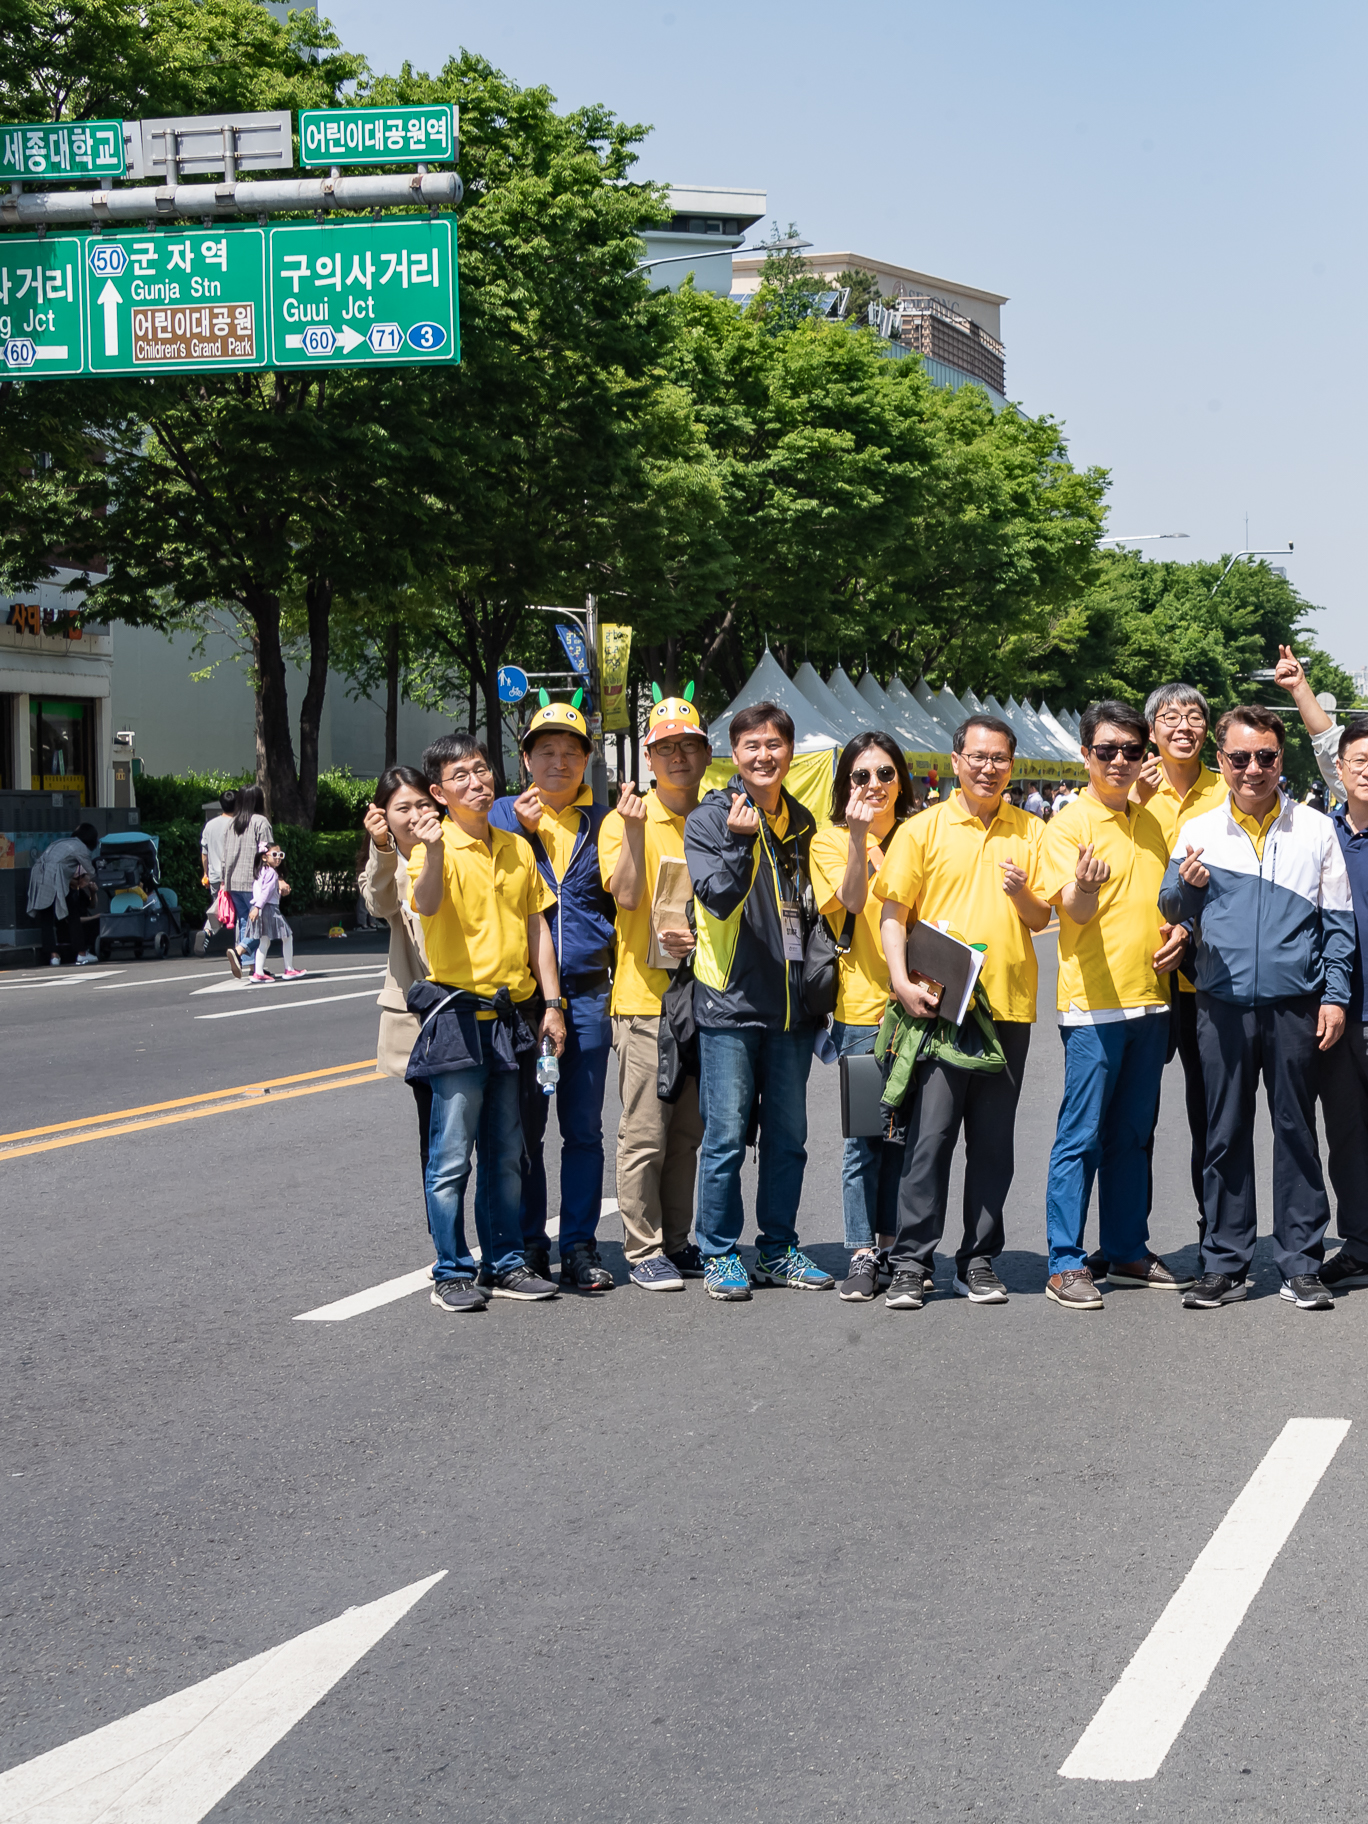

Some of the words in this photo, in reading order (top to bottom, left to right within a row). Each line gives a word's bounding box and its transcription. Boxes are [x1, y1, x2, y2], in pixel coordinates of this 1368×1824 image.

[306, 116, 447, 153] 어린이대공원역
[3, 128, 118, 172] 세종대학교
[96, 250, 121, 271] 50
[280, 248, 440, 293] 구의사거리
[131, 279, 180, 304] Gunja
[190, 276, 221, 298] Stn
[23, 308, 55, 332] Jct
[283, 297, 329, 322] Guui
[342, 295, 375, 319] Jct
[135, 306, 252, 340] 어린이대공원
[136, 341, 186, 359] Children's
[191, 338, 222, 357] Grand
[228, 337, 252, 356] Park
[309, 331, 330, 350] 60
[376, 329, 395, 348] 71
[420, 326, 434, 347] 3
[11, 343, 29, 362] 60
